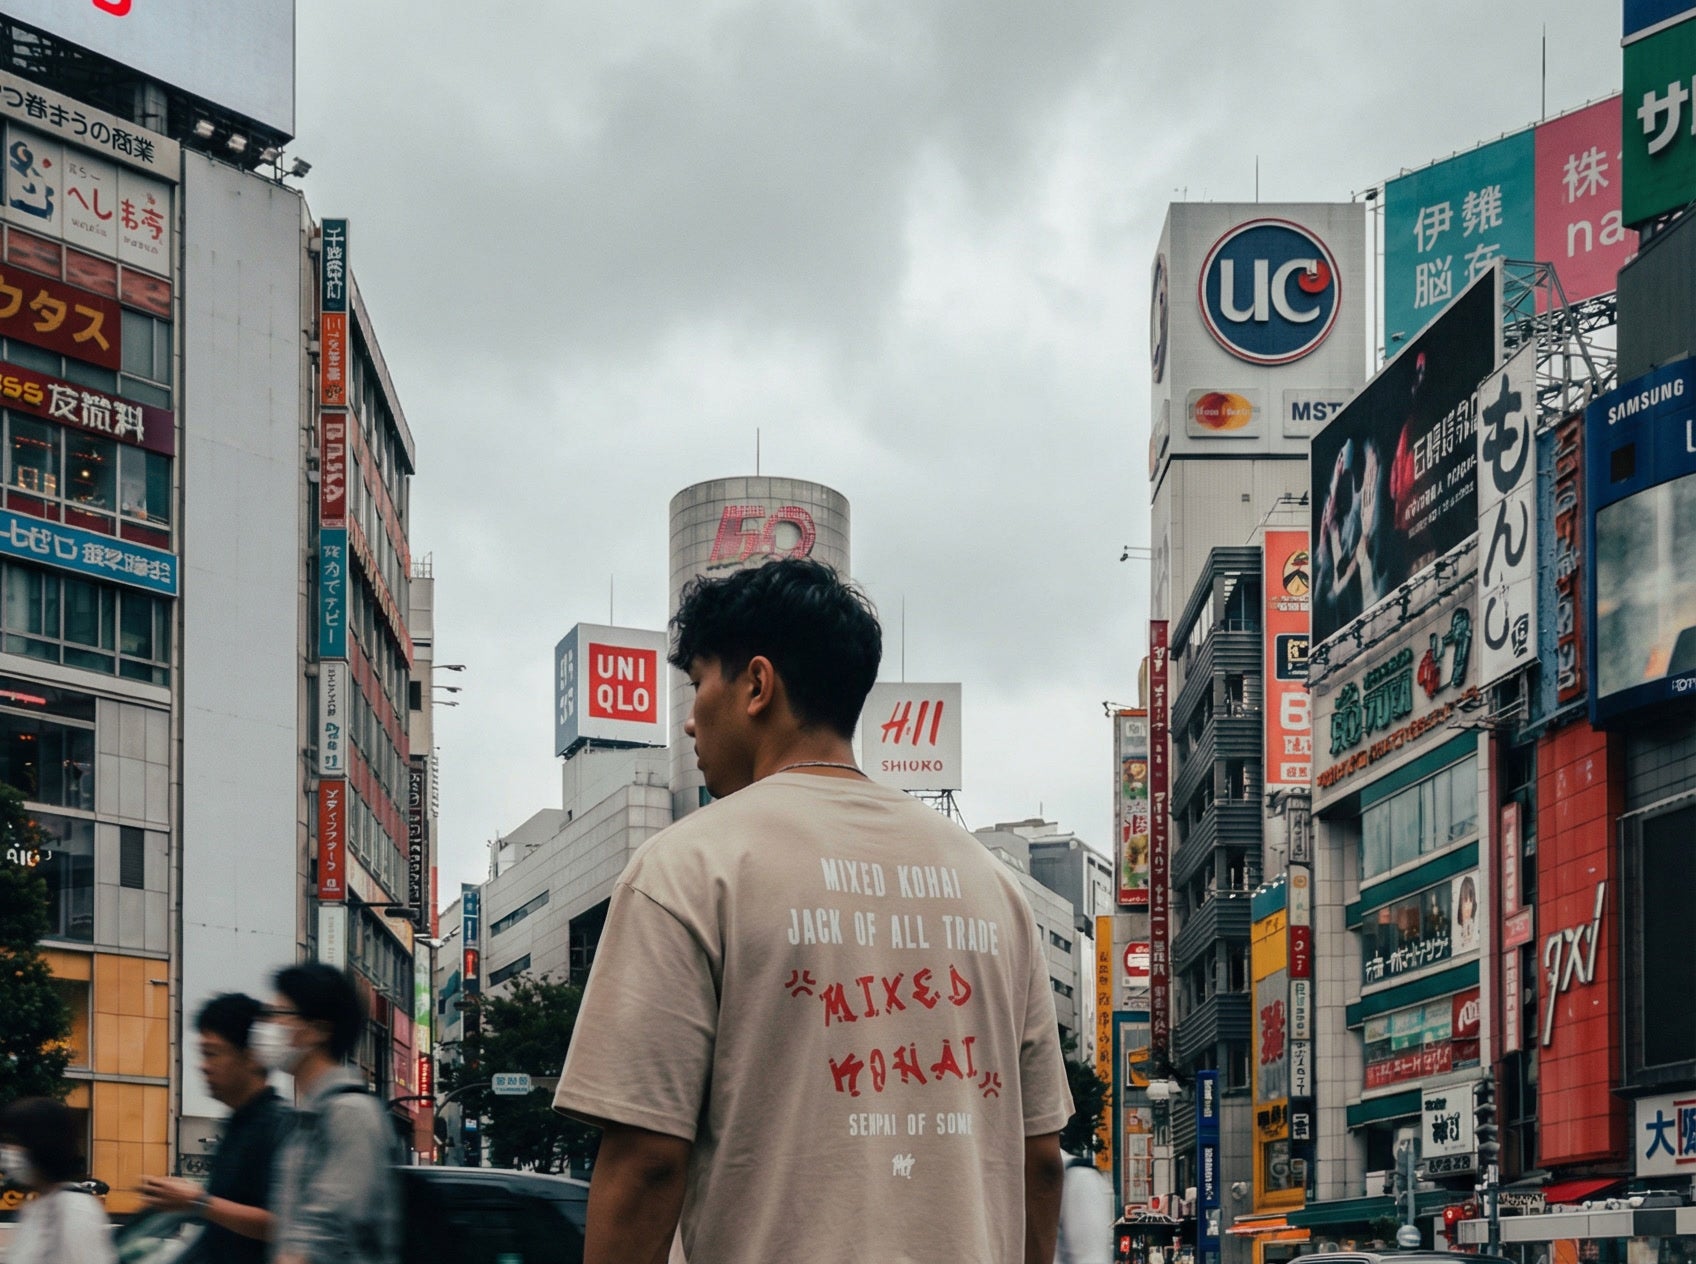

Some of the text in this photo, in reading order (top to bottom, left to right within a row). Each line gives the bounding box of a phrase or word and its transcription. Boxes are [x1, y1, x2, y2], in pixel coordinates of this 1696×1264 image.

[1637, 74, 1696, 155] サ
[1562, 146, 1622, 203] 株
[1608, 378, 1684, 425] SAMSUNG
[597, 653, 645, 682] UNI
[596, 683, 650, 714] QLO
[820, 857, 962, 899] MIXED KOHAI
[787, 908, 999, 956] JACK OF ALL TRADE
[819, 964, 972, 1027] MIXED
[907, 1113, 926, 1135] OF
